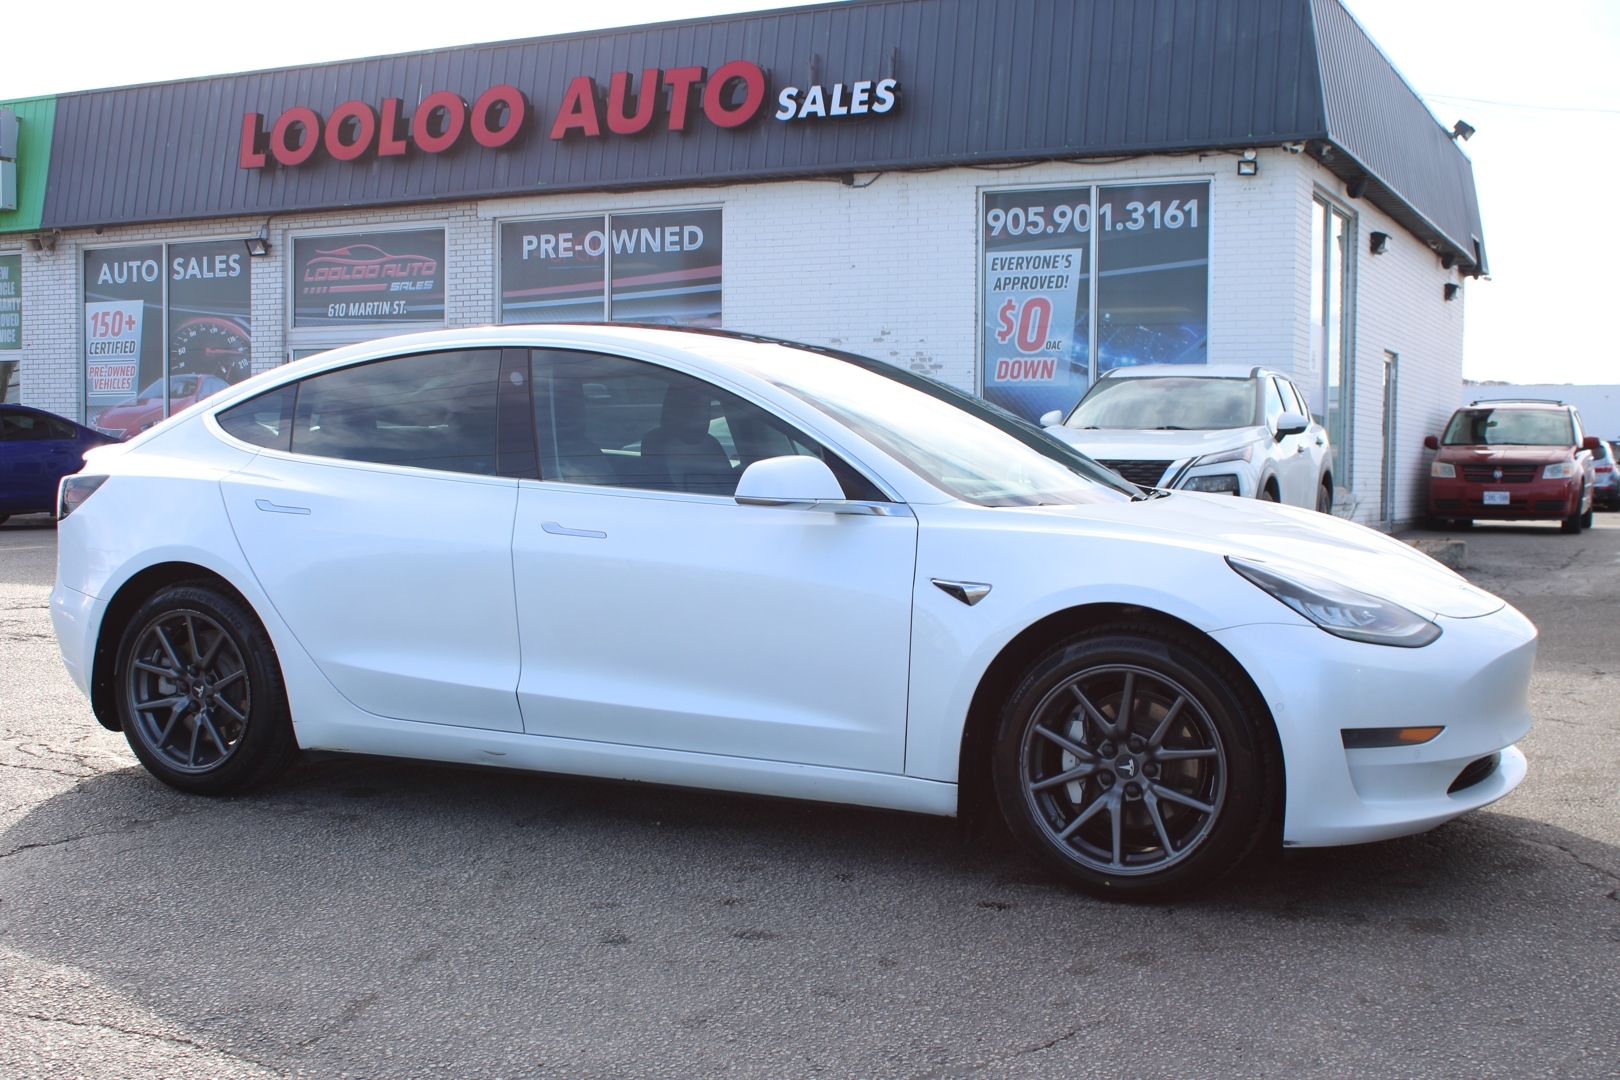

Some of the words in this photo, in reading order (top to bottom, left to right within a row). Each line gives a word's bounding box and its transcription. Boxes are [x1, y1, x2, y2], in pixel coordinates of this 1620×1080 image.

[240, 84, 527, 169] LOOLOO
[549, 60, 766, 140] AUTO
[775, 78, 897, 122] SALES
[986, 199, 1199, 237] 905.901.3161
[522, 225, 704, 259] PRE-OWNED
[97, 259, 159, 284] AUTO
[173, 254, 241, 280] SALES
[303, 265, 381, 282] LOOLOO
[381, 261, 438, 278] AUTO
[991, 254, 1073, 271] EVERYONE'S
[390, 280, 434, 292] SALES
[993, 275, 1070, 291] APPROVED!
[328, 303, 346, 317] 610
[349, 301, 391, 316] MARTIN
[393, 300, 407, 314] ST.
[90, 310, 136, 338] 150+
[997, 297, 1052, 353] $0
[1045, 340, 1062, 350] OAC
[89, 340, 136, 355] CERTIFIED
[88, 366, 136, 378] PRE-OWNED
[996, 359, 1056, 380] DOWN
[93, 378, 131, 390] VEHICLES
